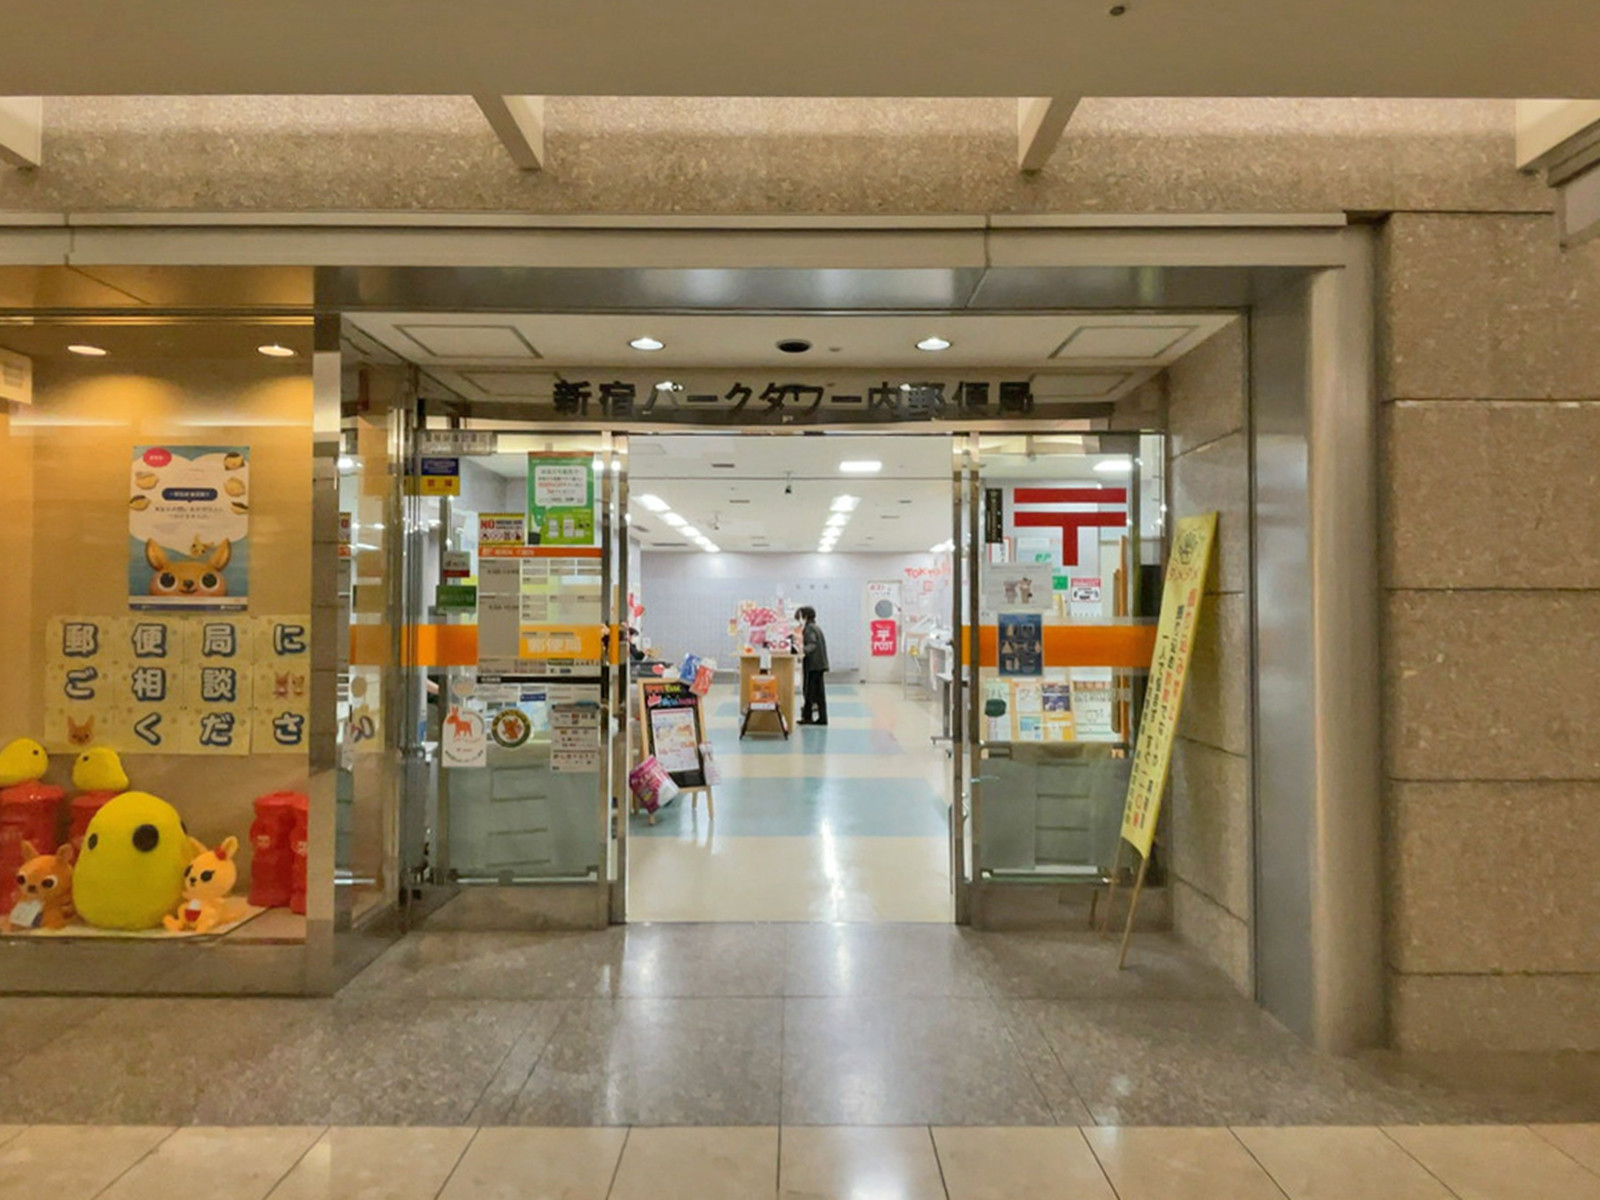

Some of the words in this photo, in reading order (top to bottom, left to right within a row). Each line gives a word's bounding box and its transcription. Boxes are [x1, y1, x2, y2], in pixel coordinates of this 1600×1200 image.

[62, 622, 307, 658] 郵便局に
[873, 641, 894, 651] POST
[64, 666, 237, 702] ご相談
